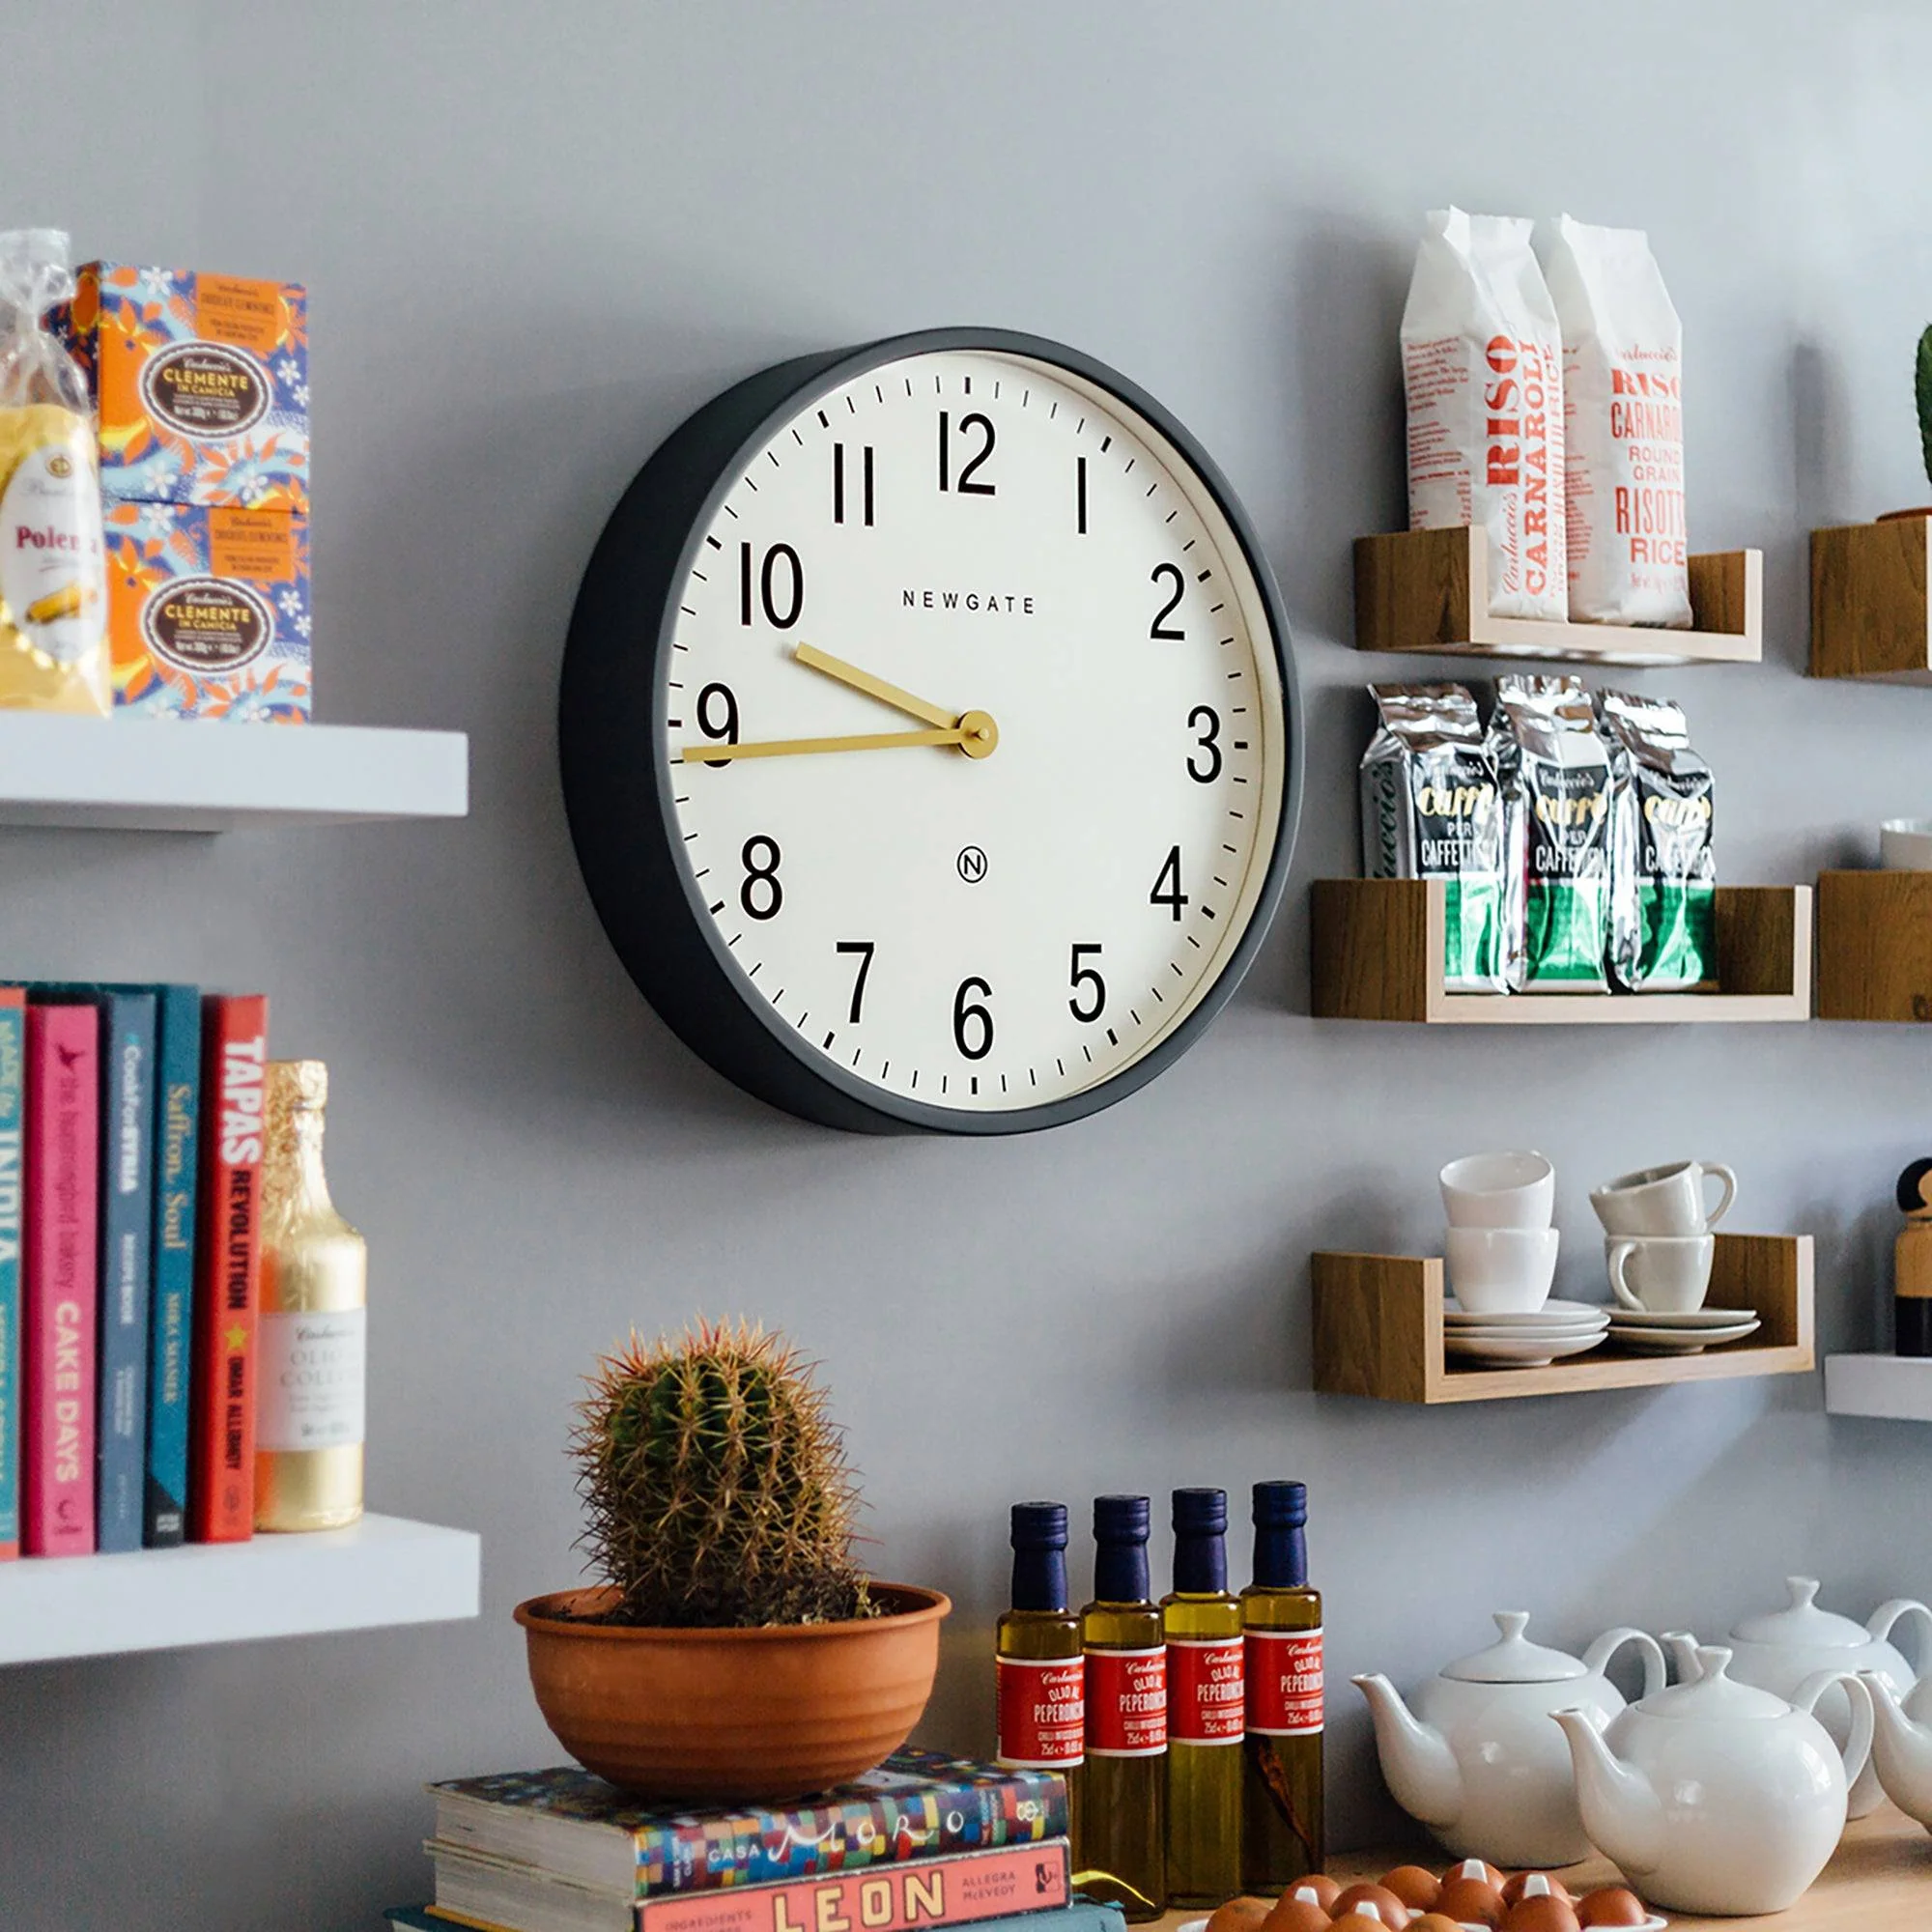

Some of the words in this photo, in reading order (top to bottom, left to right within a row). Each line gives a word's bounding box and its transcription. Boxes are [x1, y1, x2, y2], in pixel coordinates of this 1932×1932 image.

[162, 368, 249, 390] CLEMENTE
[1486, 334, 1520, 487] RISO
[834, 442, 874, 527] 11
[939, 411, 996, 496] 12
[1520, 340, 1547, 596] CARNAROLI
[1076, 456, 1088, 535] 1
[741, 542, 803, 630] 10
[1630, 537, 1686, 566] RICE
[164, 604, 250, 624] CLEMENTE
[902, 588, 1036, 615] NEWGATE
[1150, 562, 1186, 641] 2
[696, 682, 739, 769] 9
[1186, 705, 1223, 783] 3
[740, 835, 783, 921] 8
[1150, 845, 1188, 922] 4
[836, 941, 875, 1024] 7
[953, 977, 994, 1061] 6
[1068, 943, 1106, 1023] 5
[220, 1036, 265, 1166] TAPAS
[164, 1191, 190, 1249] Soul
[228, 1169, 252, 1310] REVOLUTION
[55, 1301, 81, 1392] CAKE
[54, 1399, 80, 1483] DAYS
[707, 1845, 760, 1862] CASA
[961, 1871, 1016, 1888] ALLEGRA
[774, 1870, 945, 1932] LEON
